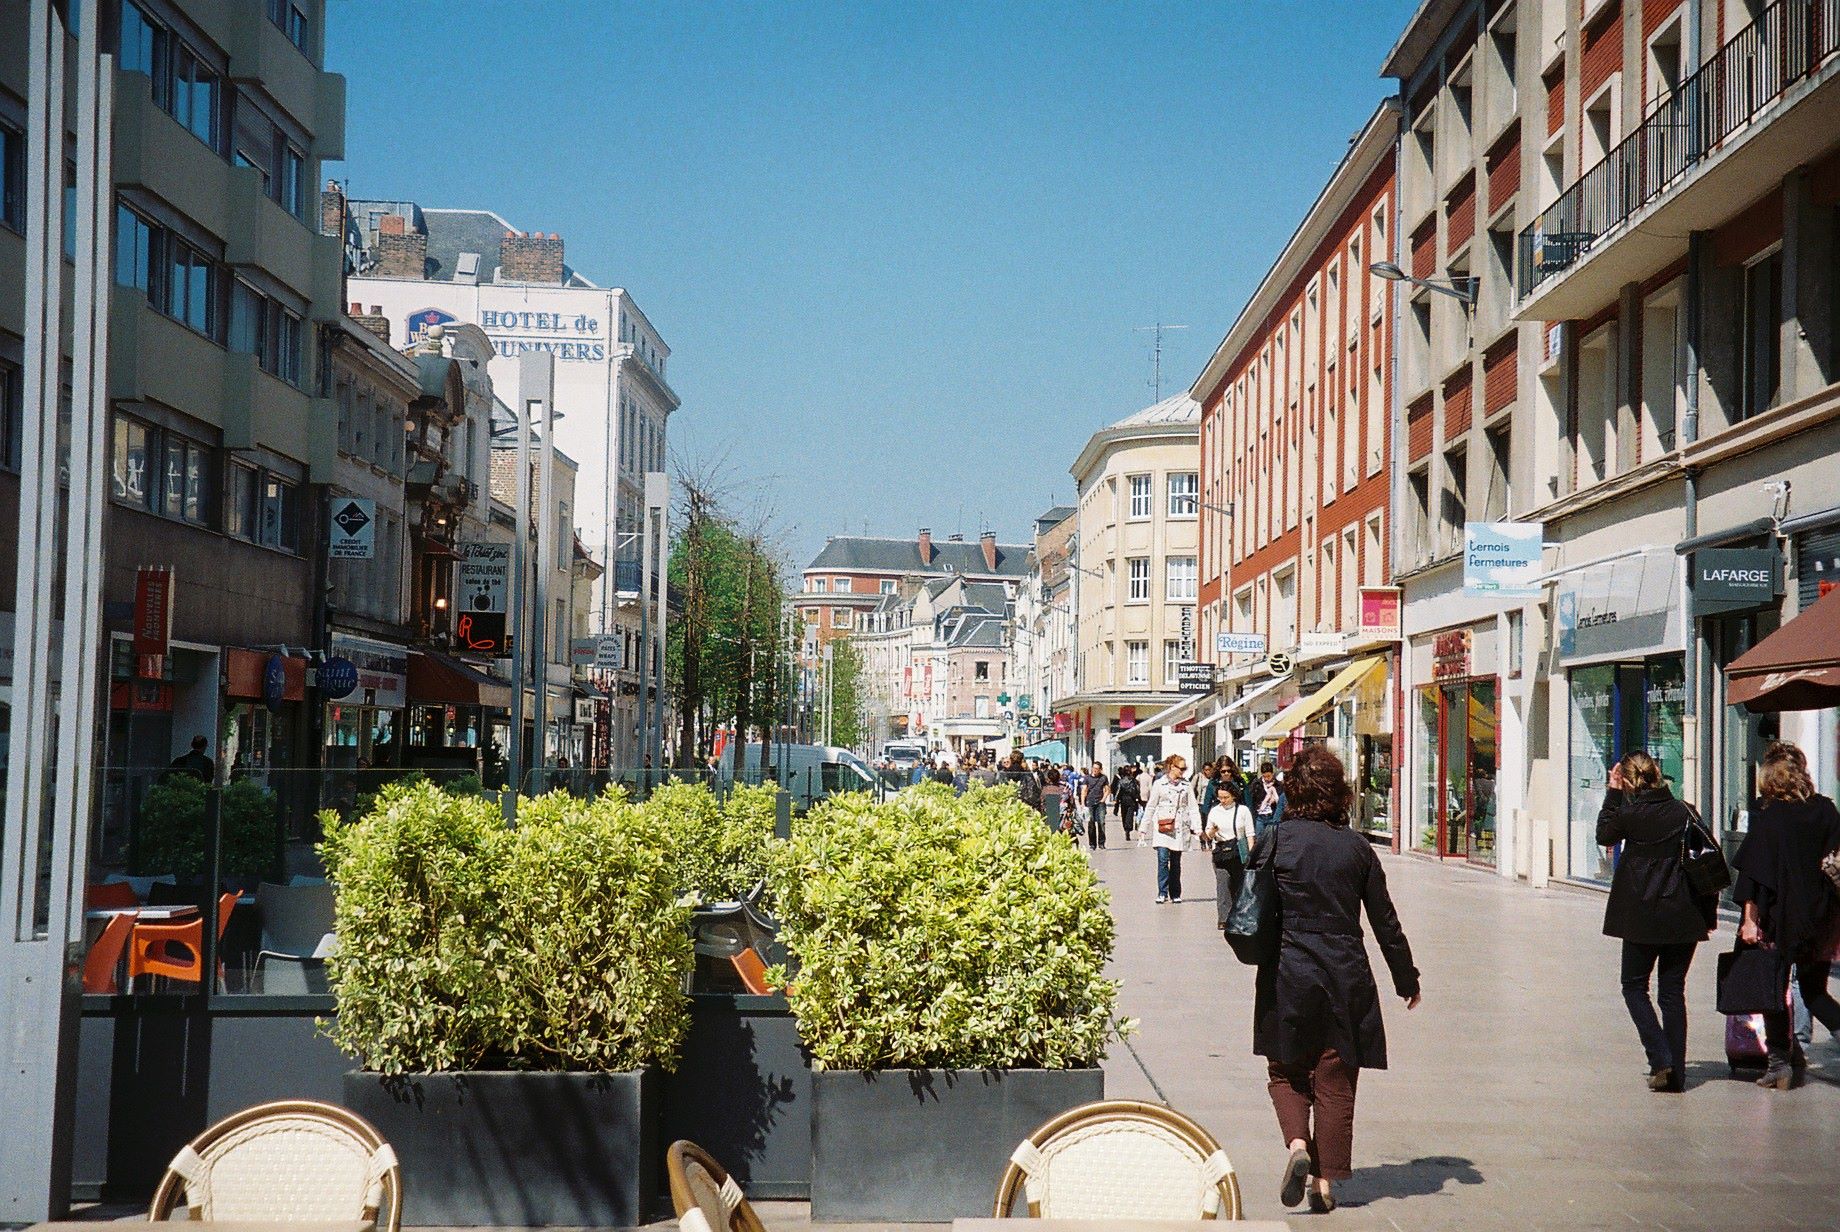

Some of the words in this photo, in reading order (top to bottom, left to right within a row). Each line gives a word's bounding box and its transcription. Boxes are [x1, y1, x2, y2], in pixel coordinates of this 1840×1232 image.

[481, 309, 567, 330] HOTEL
[574, 313, 598, 332] de
[493, 340, 604, 361] 'UNIVERS
[1469, 554, 1528, 567] fermetures
[462, 564, 506, 576] RESTAURANT
[1703, 569, 1769, 582] LAFARGE
[1218, 636, 1264, 650] Régine
